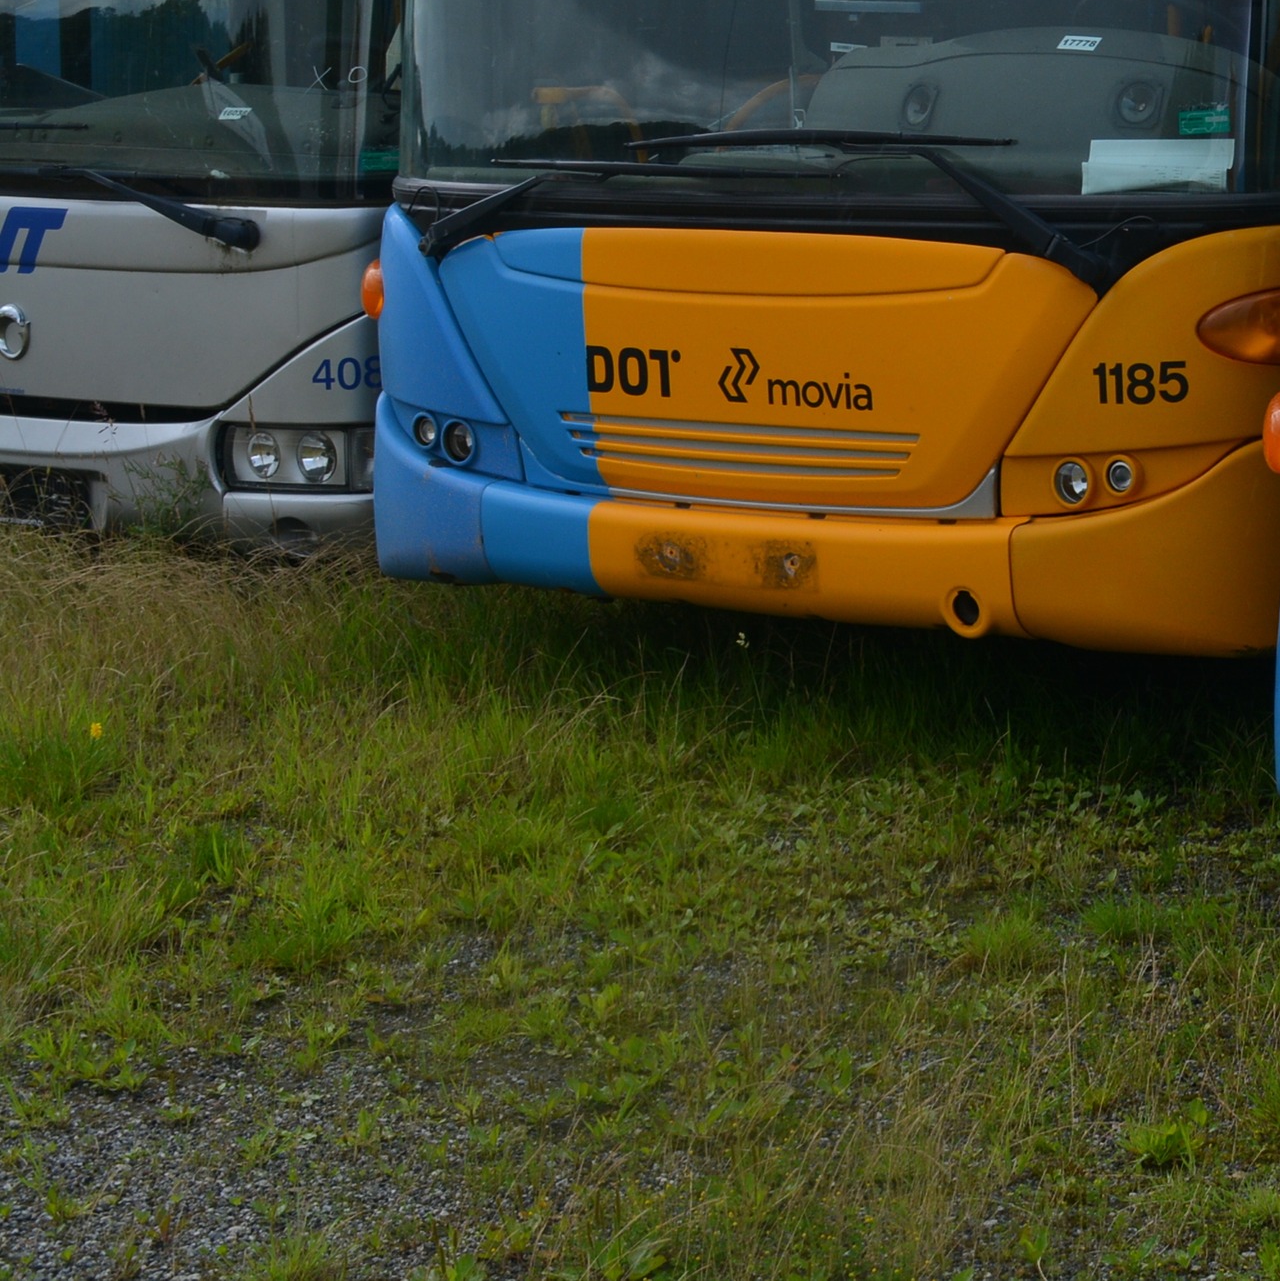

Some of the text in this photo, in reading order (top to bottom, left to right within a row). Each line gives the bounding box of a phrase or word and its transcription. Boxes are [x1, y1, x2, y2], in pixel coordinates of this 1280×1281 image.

[586, 345, 874, 412] DOT movia
[1092, 359, 1190, 407] 1185
